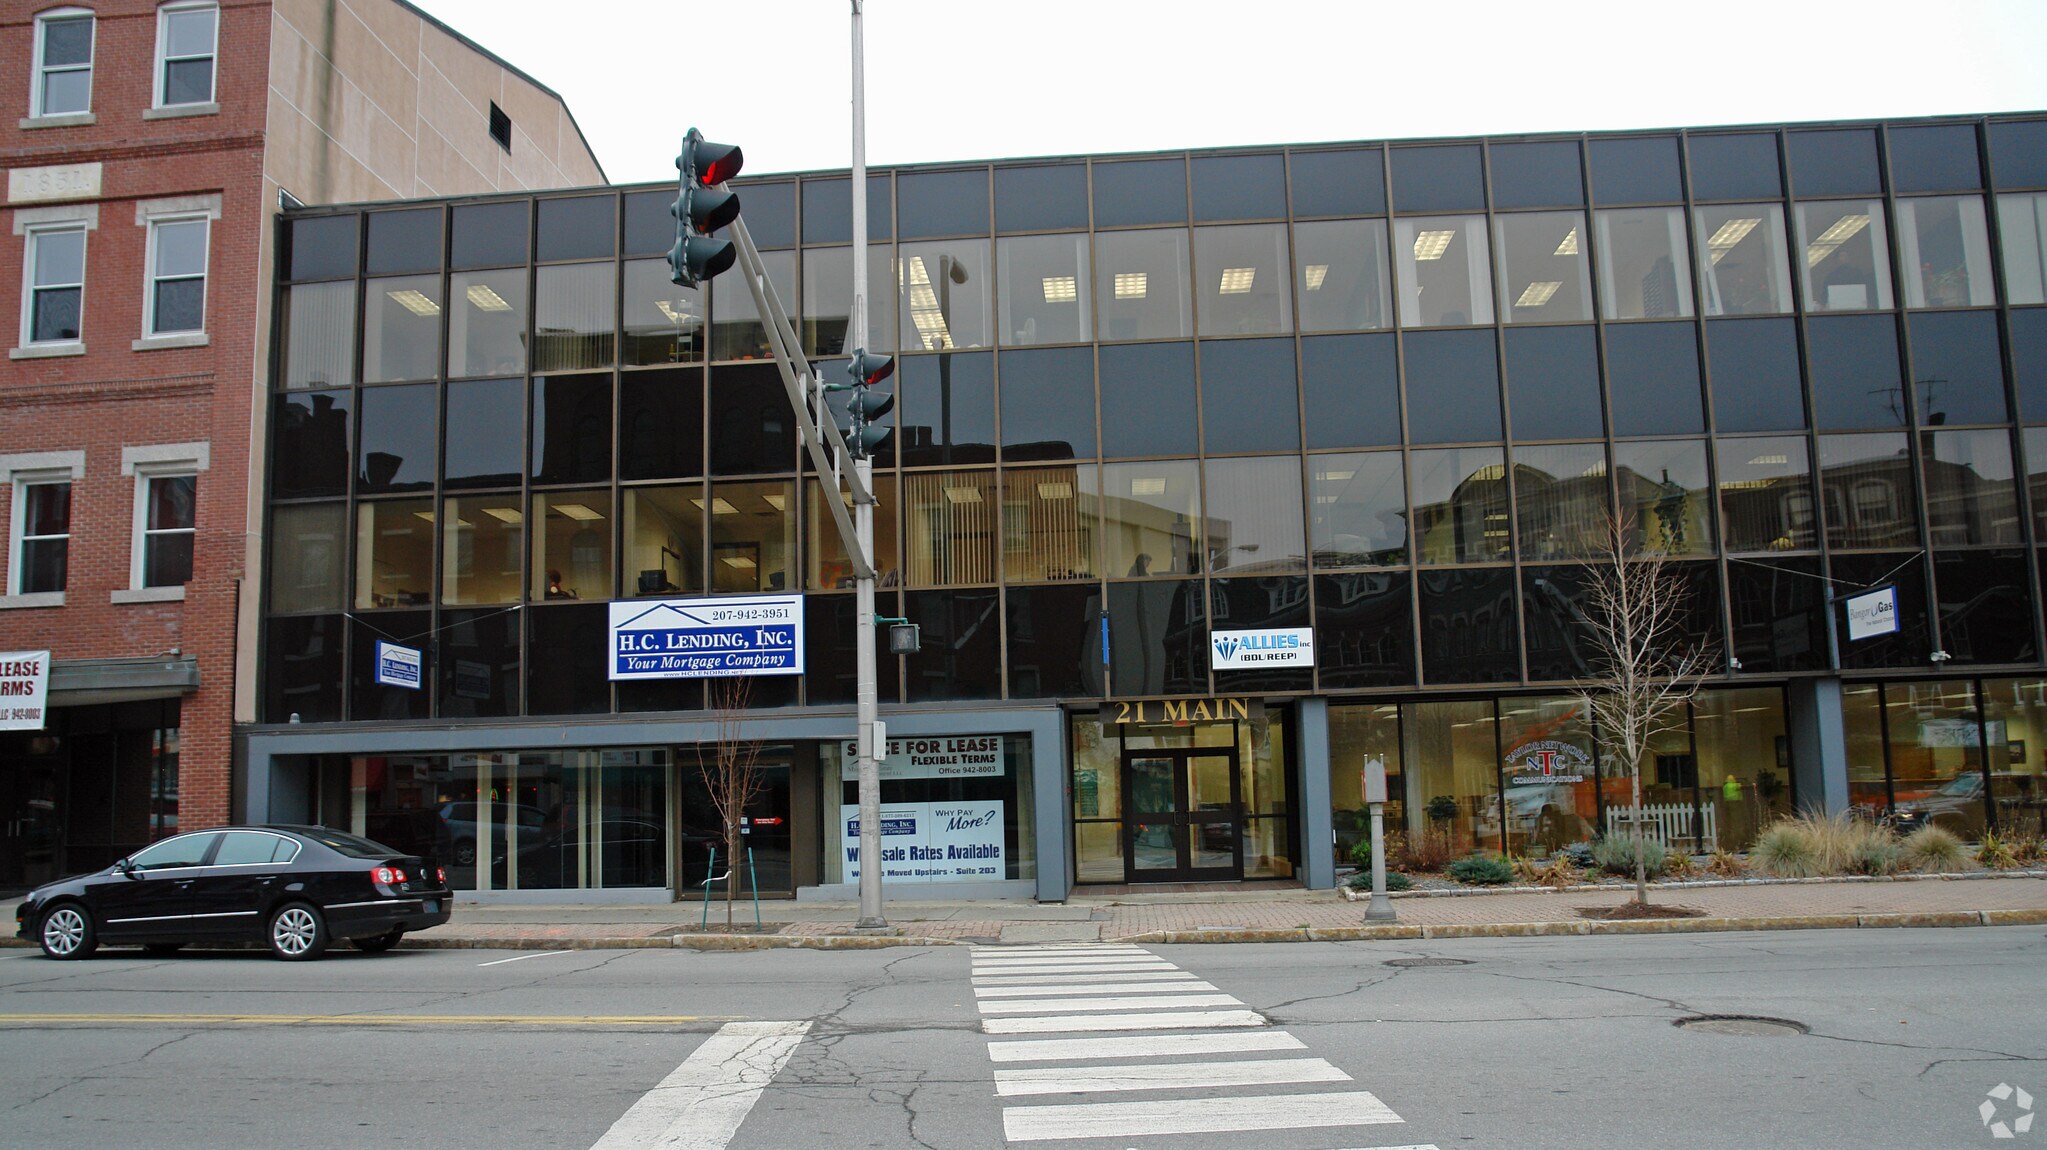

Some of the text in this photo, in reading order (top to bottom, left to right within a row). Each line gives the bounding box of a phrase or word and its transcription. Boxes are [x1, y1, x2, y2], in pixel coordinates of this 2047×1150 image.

[712, 609, 789, 621] 207-942-3951
[1878, 601, 1893, 613] Gas
[619, 629, 792, 651] H.C. LENDING, INC.
[1238, 634, 1298, 650] ALLIES
[628, 653, 786, 670] Your Mortgage Company
[0, 681, 34, 696] RMS
[1114, 698, 1249, 724] 21 MAIN
[847, 738, 998, 756] SCE FOR LEASE
[911, 754, 996, 766] FLEXIBLE TERMS
[1526, 750, 1566, 776] NTC
[962, 766, 996, 774] 942-8003
[945, 810, 996, 833] More?
[847, 844, 1000, 862] Wsale Rates Available
[915, 868, 948, 876] Upstairs
[956, 867, 976, 875] Suite
